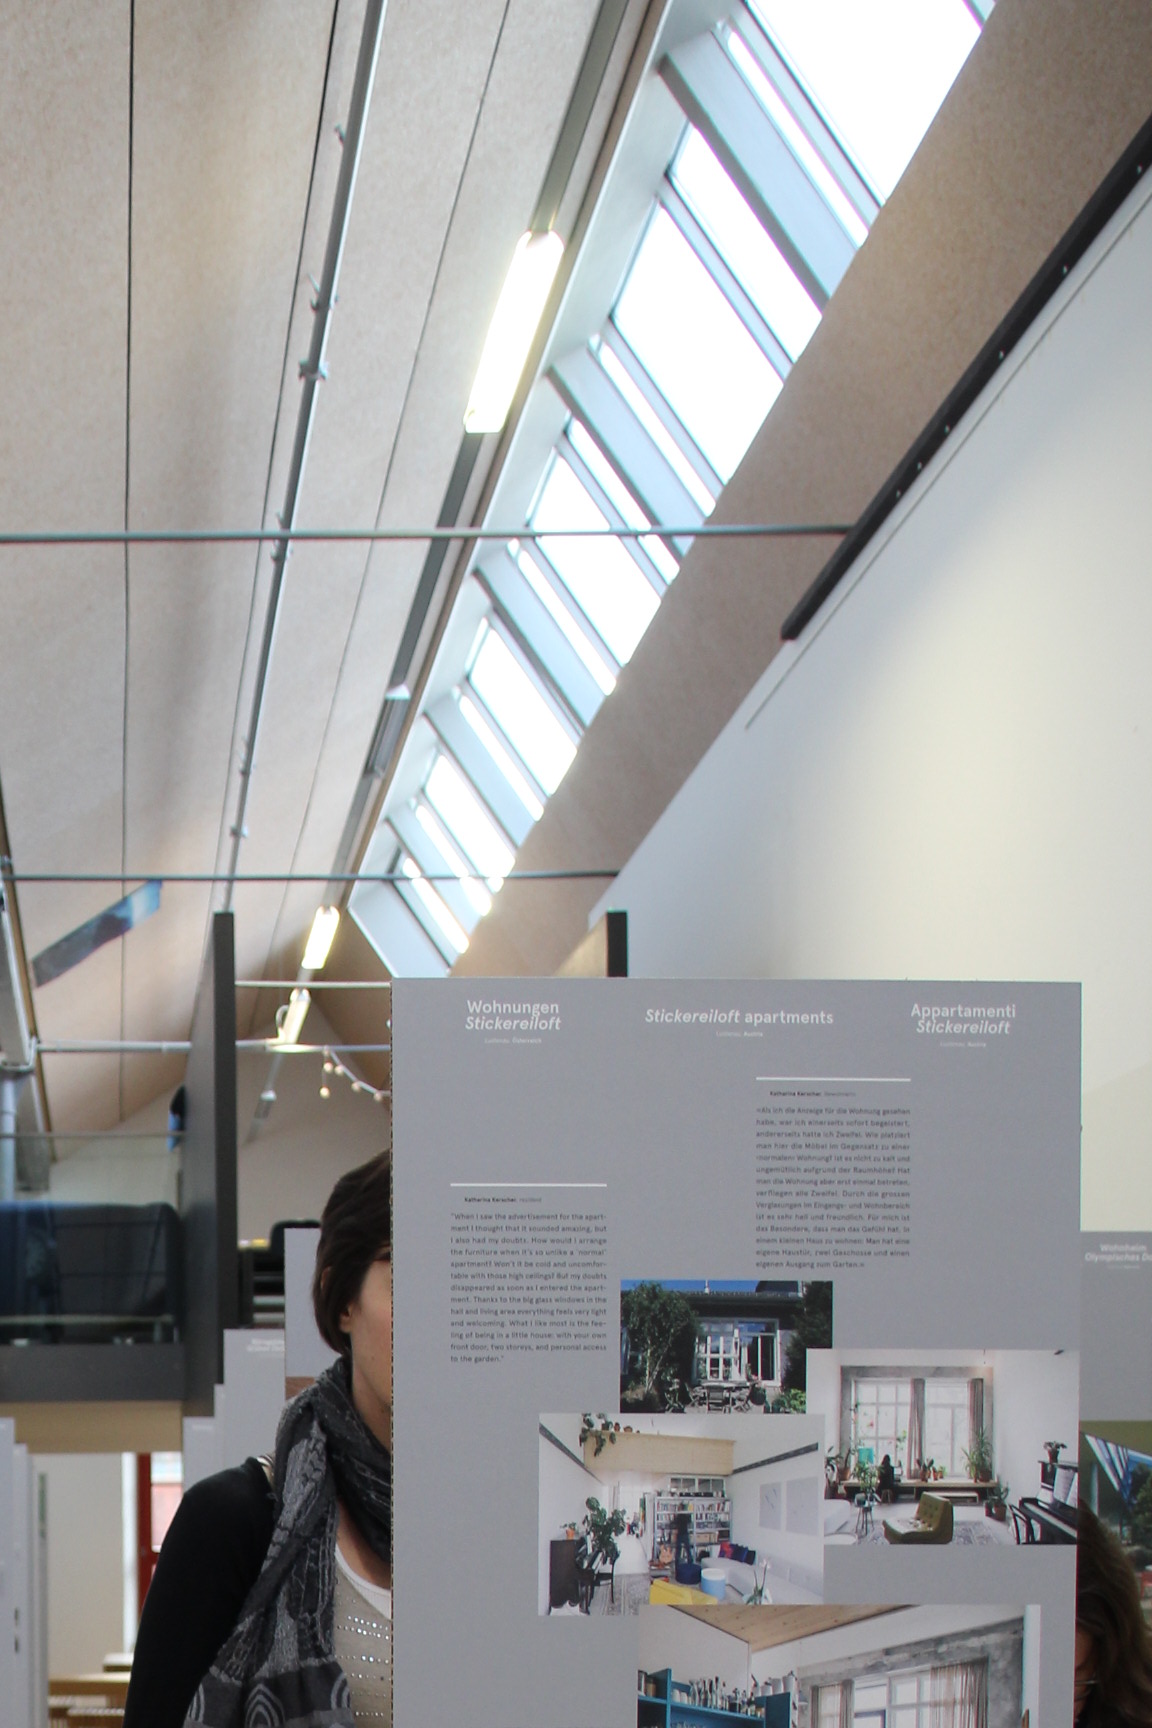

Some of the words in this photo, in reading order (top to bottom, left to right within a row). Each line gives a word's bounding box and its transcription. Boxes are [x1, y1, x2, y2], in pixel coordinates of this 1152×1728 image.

[467, 1000, 559, 1017] Wohnungen
[911, 1003, 1016, 1020] Appartamenti
[465, 1015, 561, 1030] Stickereiloft
[645, 1008, 741, 1023] Stickereiloft
[744, 1010, 834, 1027] apartments
[916, 1020, 1011, 1035] Stickereiloft
